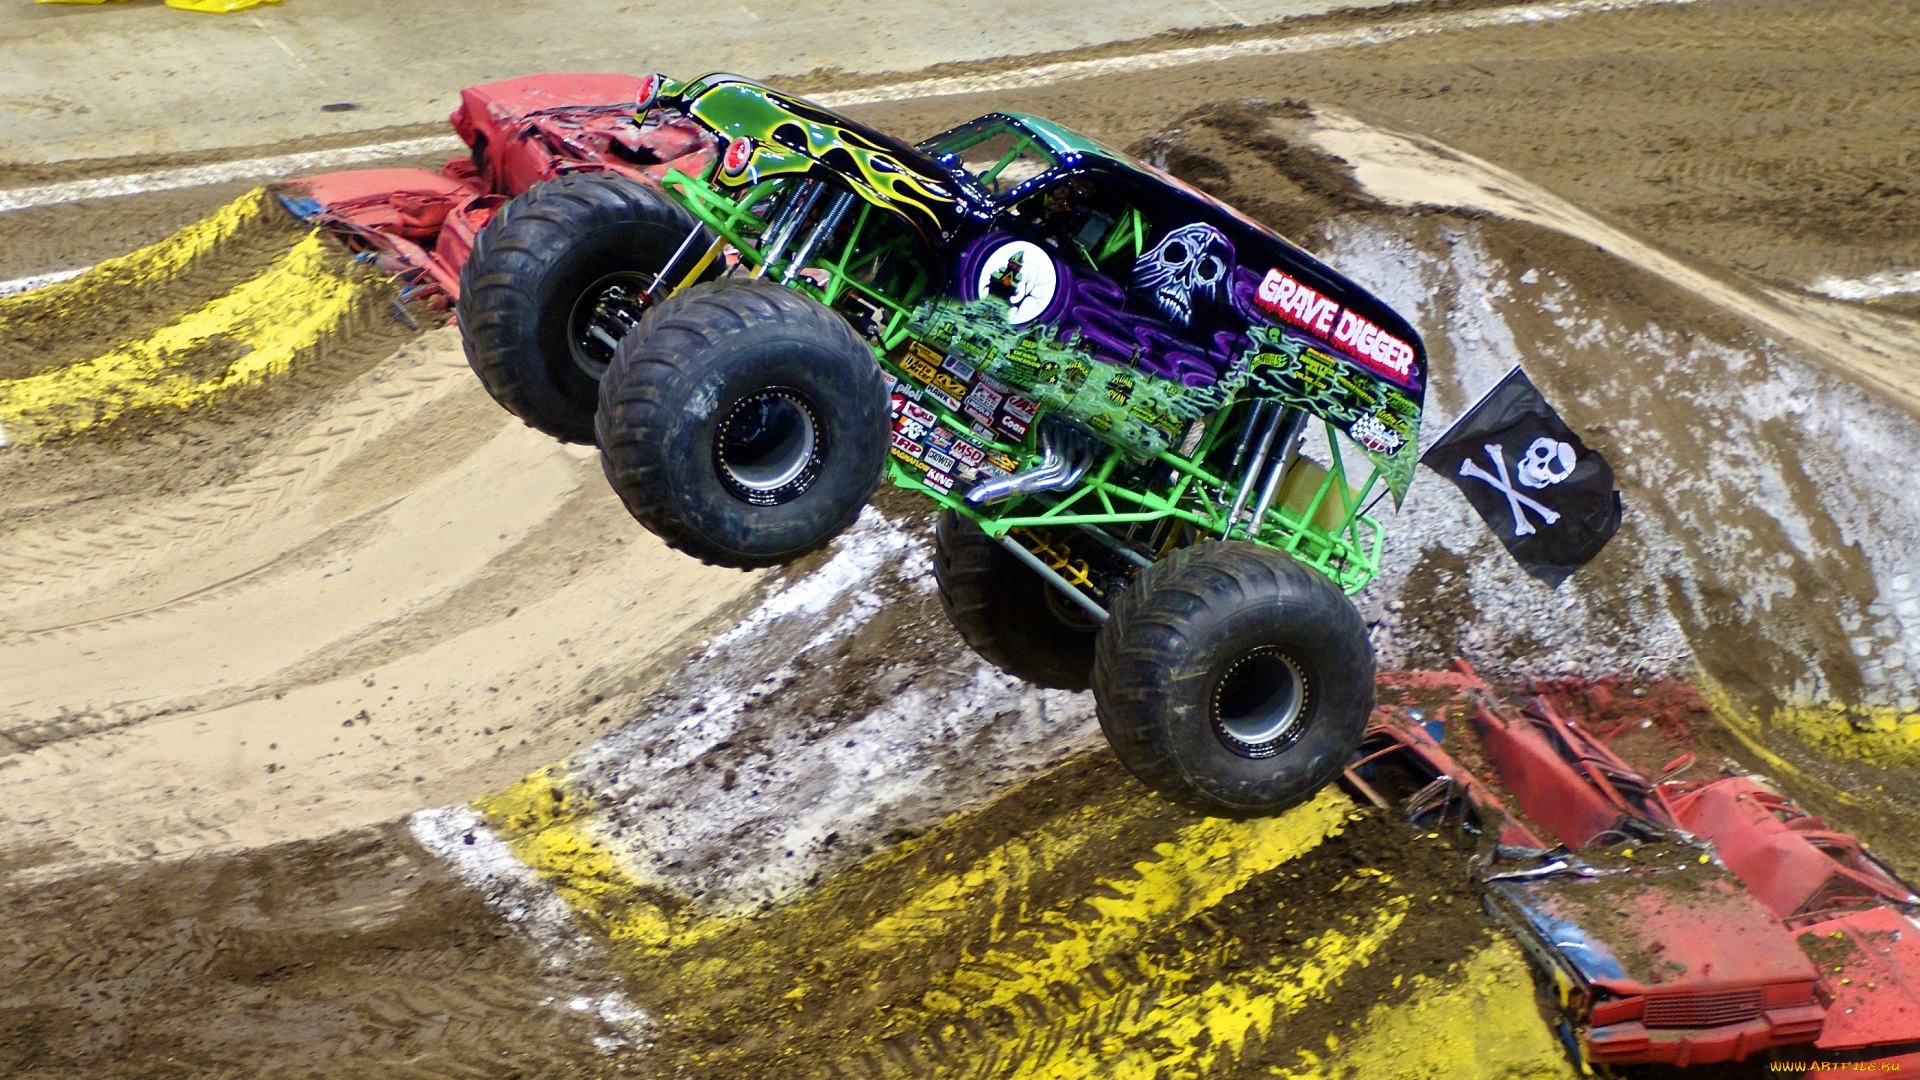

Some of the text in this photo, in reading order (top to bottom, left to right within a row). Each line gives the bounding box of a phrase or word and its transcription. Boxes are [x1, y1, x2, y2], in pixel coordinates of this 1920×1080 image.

[1257, 267, 1415, 377] GRAVE DIGGER
[906, 364, 932, 381] Meter
[913, 360, 932, 374] Auto
[1111, 374, 1133, 389] ADAM
[895, 383, 924, 402] piloti
[926, 384, 950, 403] HAWK
[1105, 389, 1127, 407] RYAN
[908, 403, 934, 422] WORLD
[966, 397, 992, 418] LINCOLN
[1008, 396, 1036, 417] JAZ
[1001, 415, 1026, 435] Coan
[891, 433, 922, 453] ARP
[953, 441, 982, 461] MSD
[927, 450, 954, 469] CROWER
[926, 468, 954, 489] KING
